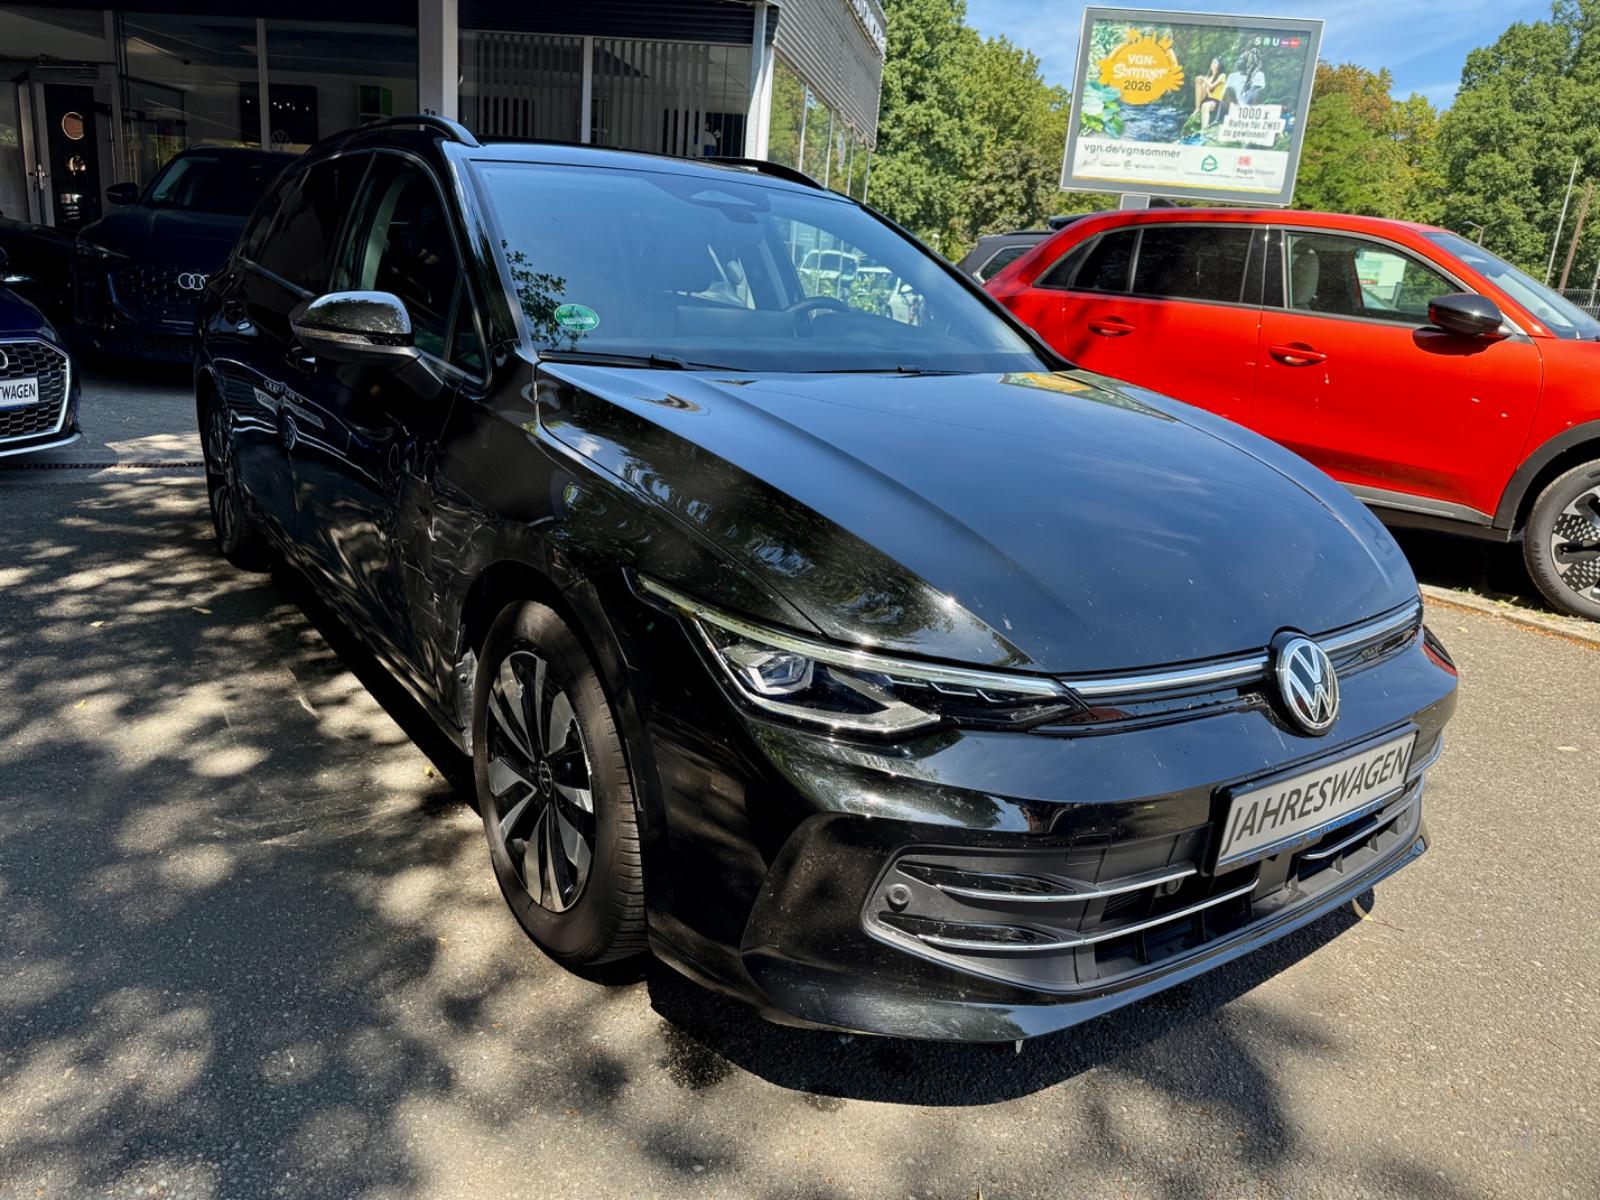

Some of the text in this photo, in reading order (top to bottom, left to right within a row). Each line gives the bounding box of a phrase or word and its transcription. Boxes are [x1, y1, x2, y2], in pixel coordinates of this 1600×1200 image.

[1128, 54, 1157, 66] VGN-
[1113, 63, 1168, 82] Sommer
[1124, 80, 1152, 92] 2026
[1238, 106, 1262, 120] 1000
[1262, 121, 1282, 131] ZWEI
[1084, 142, 1182, 159] vgn.de/vgnsommer
[1220, 742, 1411, 856] JAHRESWAGEN
